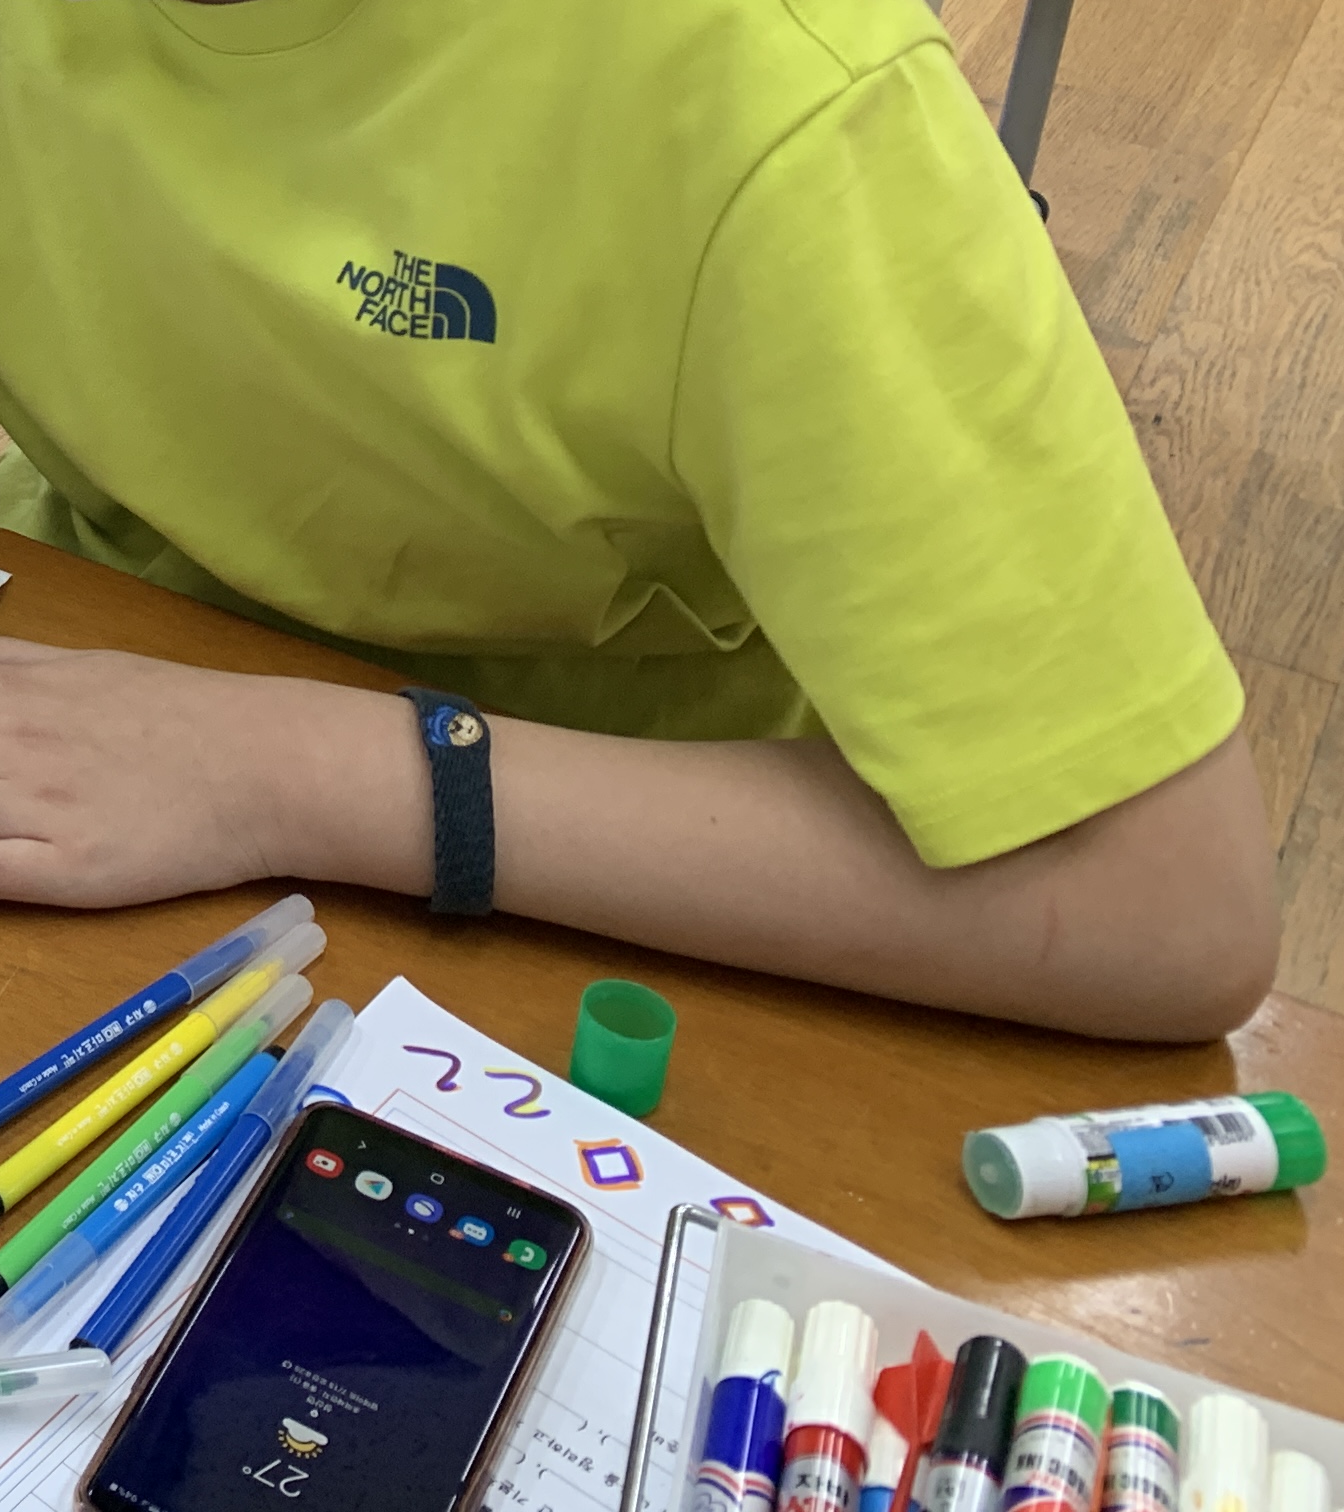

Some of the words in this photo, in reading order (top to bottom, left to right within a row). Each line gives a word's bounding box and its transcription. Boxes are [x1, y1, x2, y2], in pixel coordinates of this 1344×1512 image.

[336, 260, 431, 314] NORTH
[393, 249, 433, 287] THE
[355, 298, 430, 339] FACE
[531, 1428, 593, 1472] 정리하고
[241, 1458, 309, 1497] 27°
